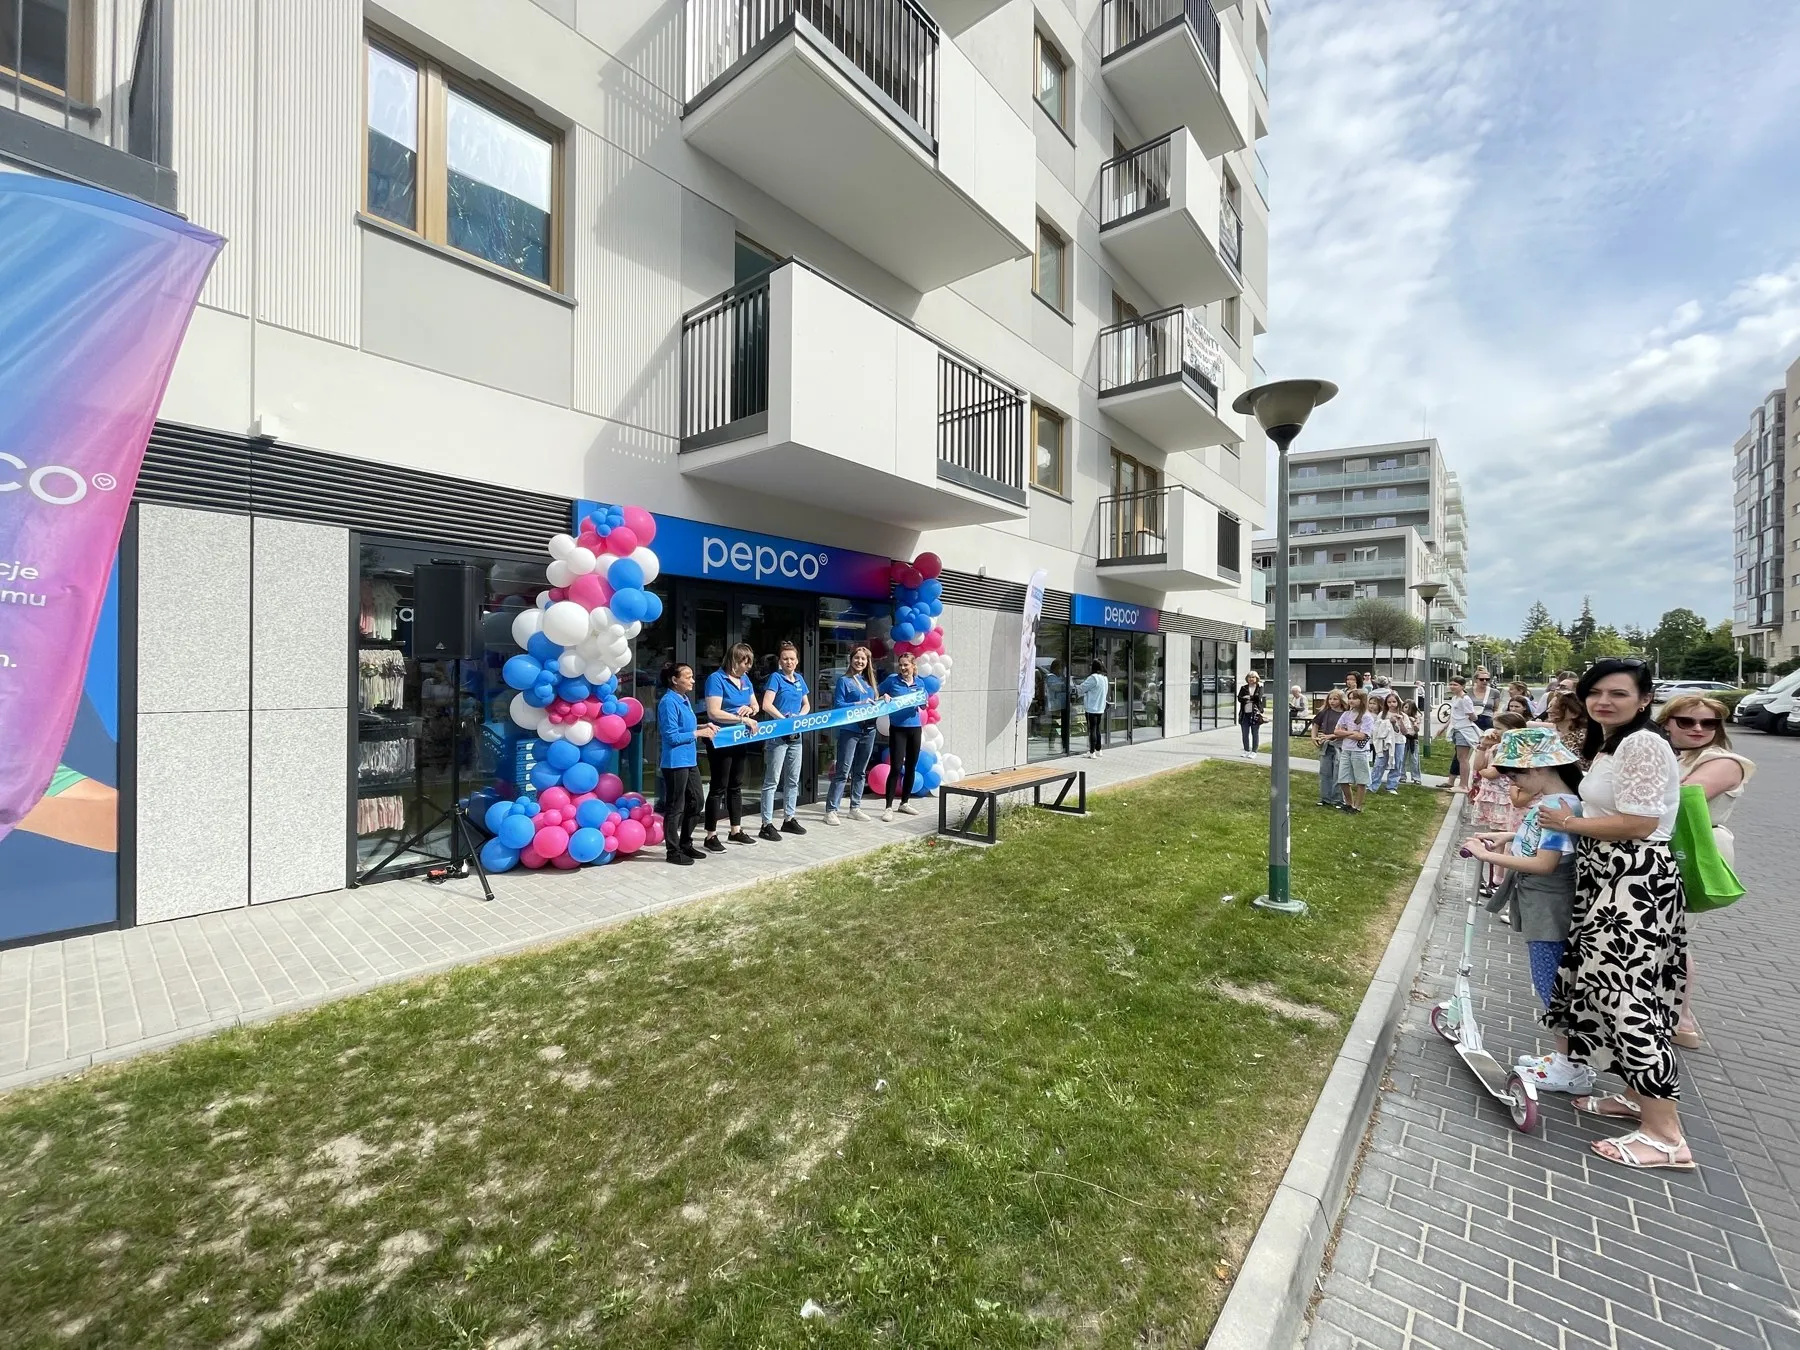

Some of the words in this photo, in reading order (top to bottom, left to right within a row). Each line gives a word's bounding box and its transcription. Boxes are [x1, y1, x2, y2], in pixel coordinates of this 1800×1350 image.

[703, 536, 819, 580] pepco
[1104, 605, 1137, 627] pepco
[846, 704, 880, 720] pepco
[793, 714, 829, 731] pepco
